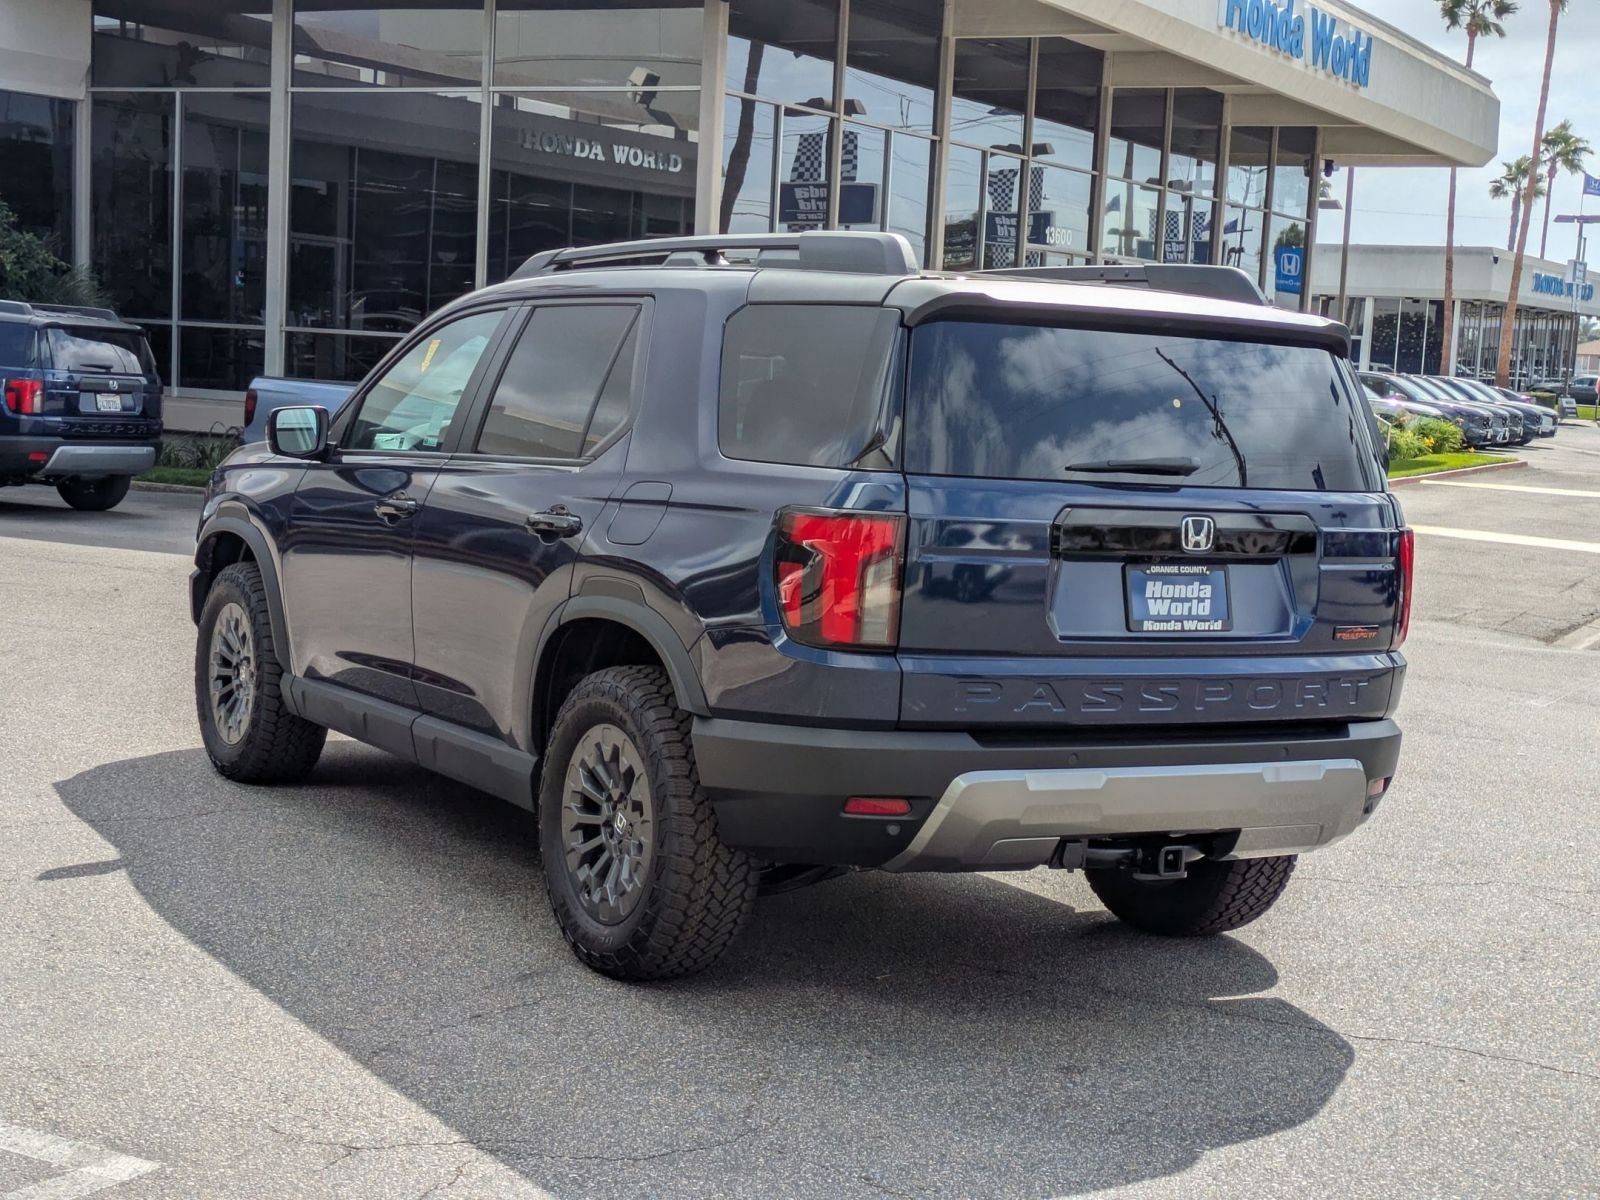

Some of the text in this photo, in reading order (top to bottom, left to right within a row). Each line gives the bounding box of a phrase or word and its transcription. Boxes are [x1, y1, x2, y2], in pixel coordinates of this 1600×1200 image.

[1311, 7, 1373, 88] World
[520, 127, 682, 173] HONDA WORLD
[1045, 226, 1072, 246] 13600
[1150, 565, 1208, 574] ORANGE COUNTY
[1145, 581, 1212, 598] Honda
[1147, 599, 1211, 616] World
[1143, 619, 1222, 631] Honda World
[954, 675, 1370, 713] PASSPORT
